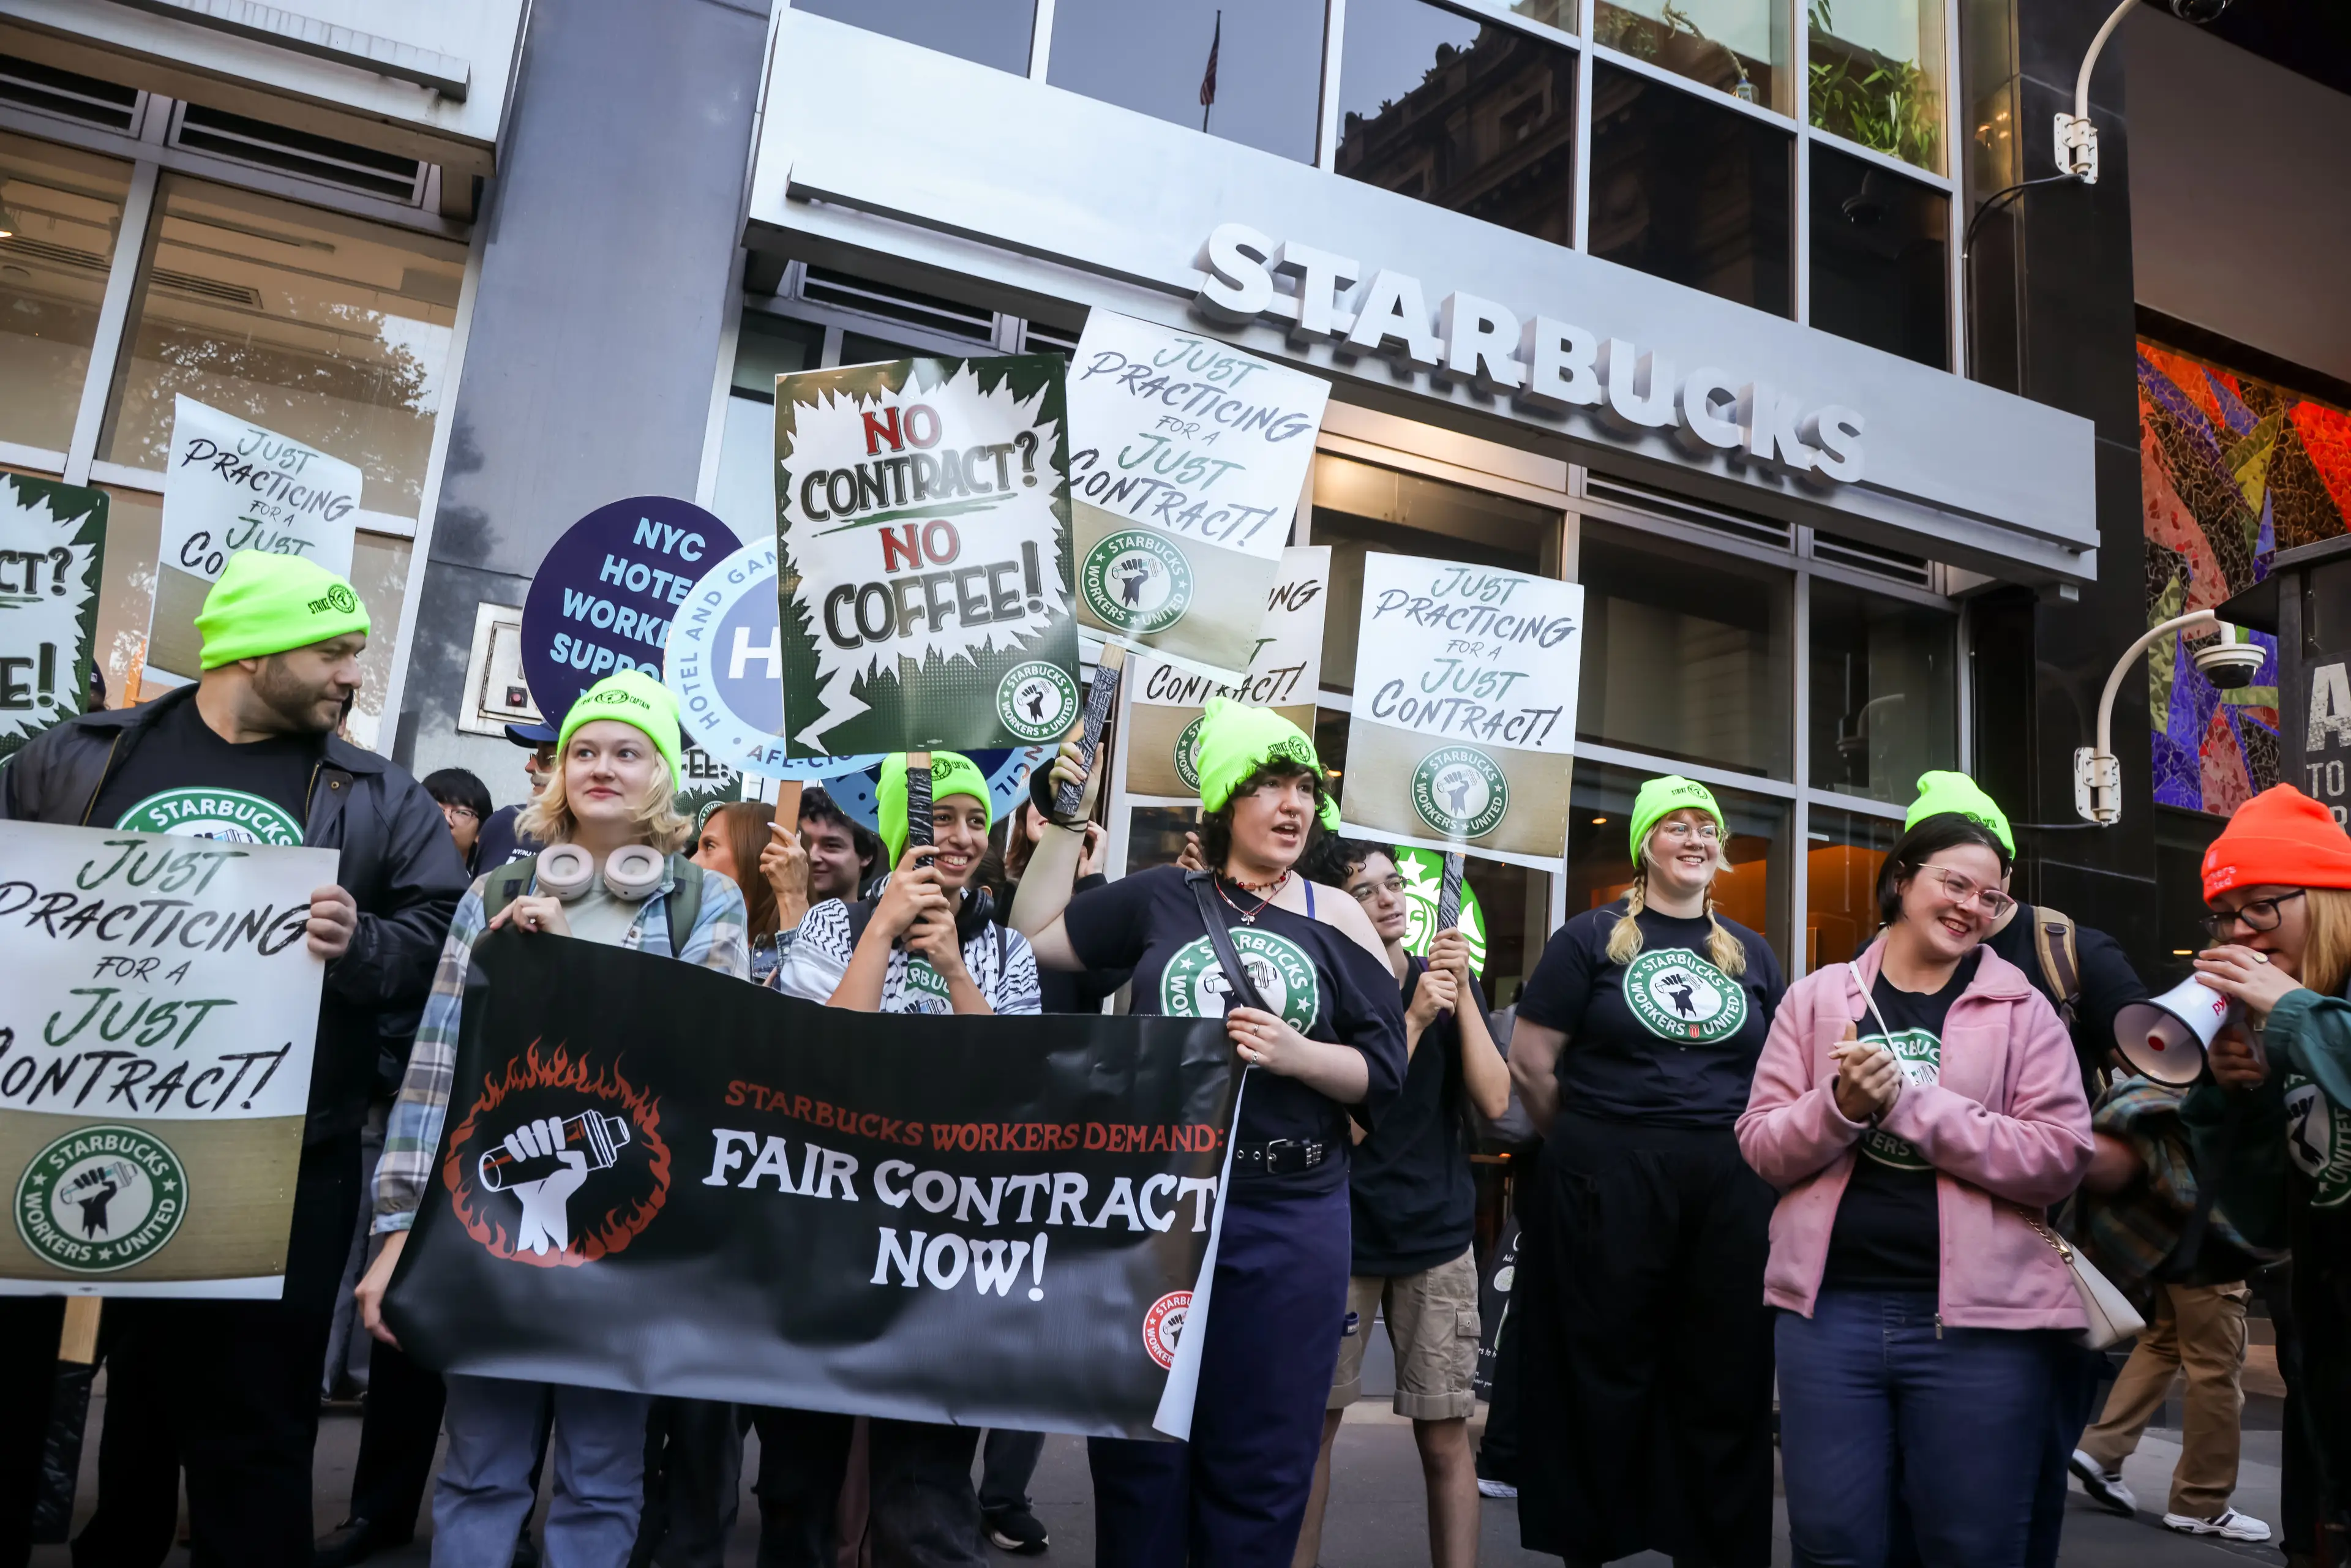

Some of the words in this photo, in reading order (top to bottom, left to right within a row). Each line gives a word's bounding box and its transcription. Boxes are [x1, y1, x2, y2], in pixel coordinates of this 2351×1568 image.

[1153, 337, 1269, 389] JUST
[1195, 223, 1865, 482] STARBUCKS
[1080, 351, 1313, 442] PRACTICING
[238, 429, 318, 475] JUST
[861, 404, 942, 456] NO
[1155, 415, 1201, 441] FOR
[1201, 430, 1221, 446] A
[181, 438, 353, 523] PRACTICING
[800, 430, 1040, 522] CONTRACT?
[1117, 432, 1246, 491] JUST
[249, 499, 282, 522] FOR
[283, 513, 294, 528] A
[1068, 448, 1279, 547] CONTRACT!
[225, 516, 315, 556] JUST
[632, 517, 707, 562] NYC
[879, 520, 960, 573] NO
[1108, 536, 1184, 576] STARBUCKS
[599, 553, 699, 607] HOTE
[823, 540, 1044, 650] COFFEE!
[1087, 565, 1127, 622] WORKERS
[1142, 592, 1185, 626] UNITED
[1430, 567, 1531, 606] JUST
[307, 598, 332, 615] STRIKE
[685, 590, 722, 642] AND
[1372, 588, 1577, 648] PRACTICING
[1446, 639, 1485, 658] FOR
[1487, 644, 1503, 662] A
[680, 651, 721, 730] HOTEL
[1006, 665, 1066, 690] STARBUCKS
[1420, 658, 1531, 702] JUST
[1001, 700, 1040, 737] WORKERS
[1049, 696, 1074, 733] UNITED
[1371, 678, 1564, 747] CONTRACT!
[1429, 751, 1498, 782] STARBUCKS
[149, 798, 293, 847] STARBUCKS
[1415, 782, 1458, 830] WORKERS
[1470, 796, 1503, 831] UNITED
[76, 838, 250, 896] JUST
[92, 955, 160, 983] FOR
[164, 959, 192, 986] A
[1199, 933, 1309, 991] SRBUCKS
[1641, 953, 1725, 988] STARBUCKS
[43, 987, 239, 1051] JUST
[1629, 981, 1685, 1037] WORKERS
[1702, 996, 1740, 1036] UNITED
[724, 1079, 925, 1148] STARBUCKS
[930, 1122, 1080, 1153] WORKERS
[1084, 1122, 1224, 1153] DEMAND:
[48, 1134, 170, 1177] STARBUCKS
[702, 1128, 860, 1202] FAIR
[872, 1158, 1220, 1233] CONTRACT
[24, 1190, 93, 1262] WORKERS
[115, 1198, 176, 1257] UNITED
[869, 1226, 1049, 1302] NOW!
